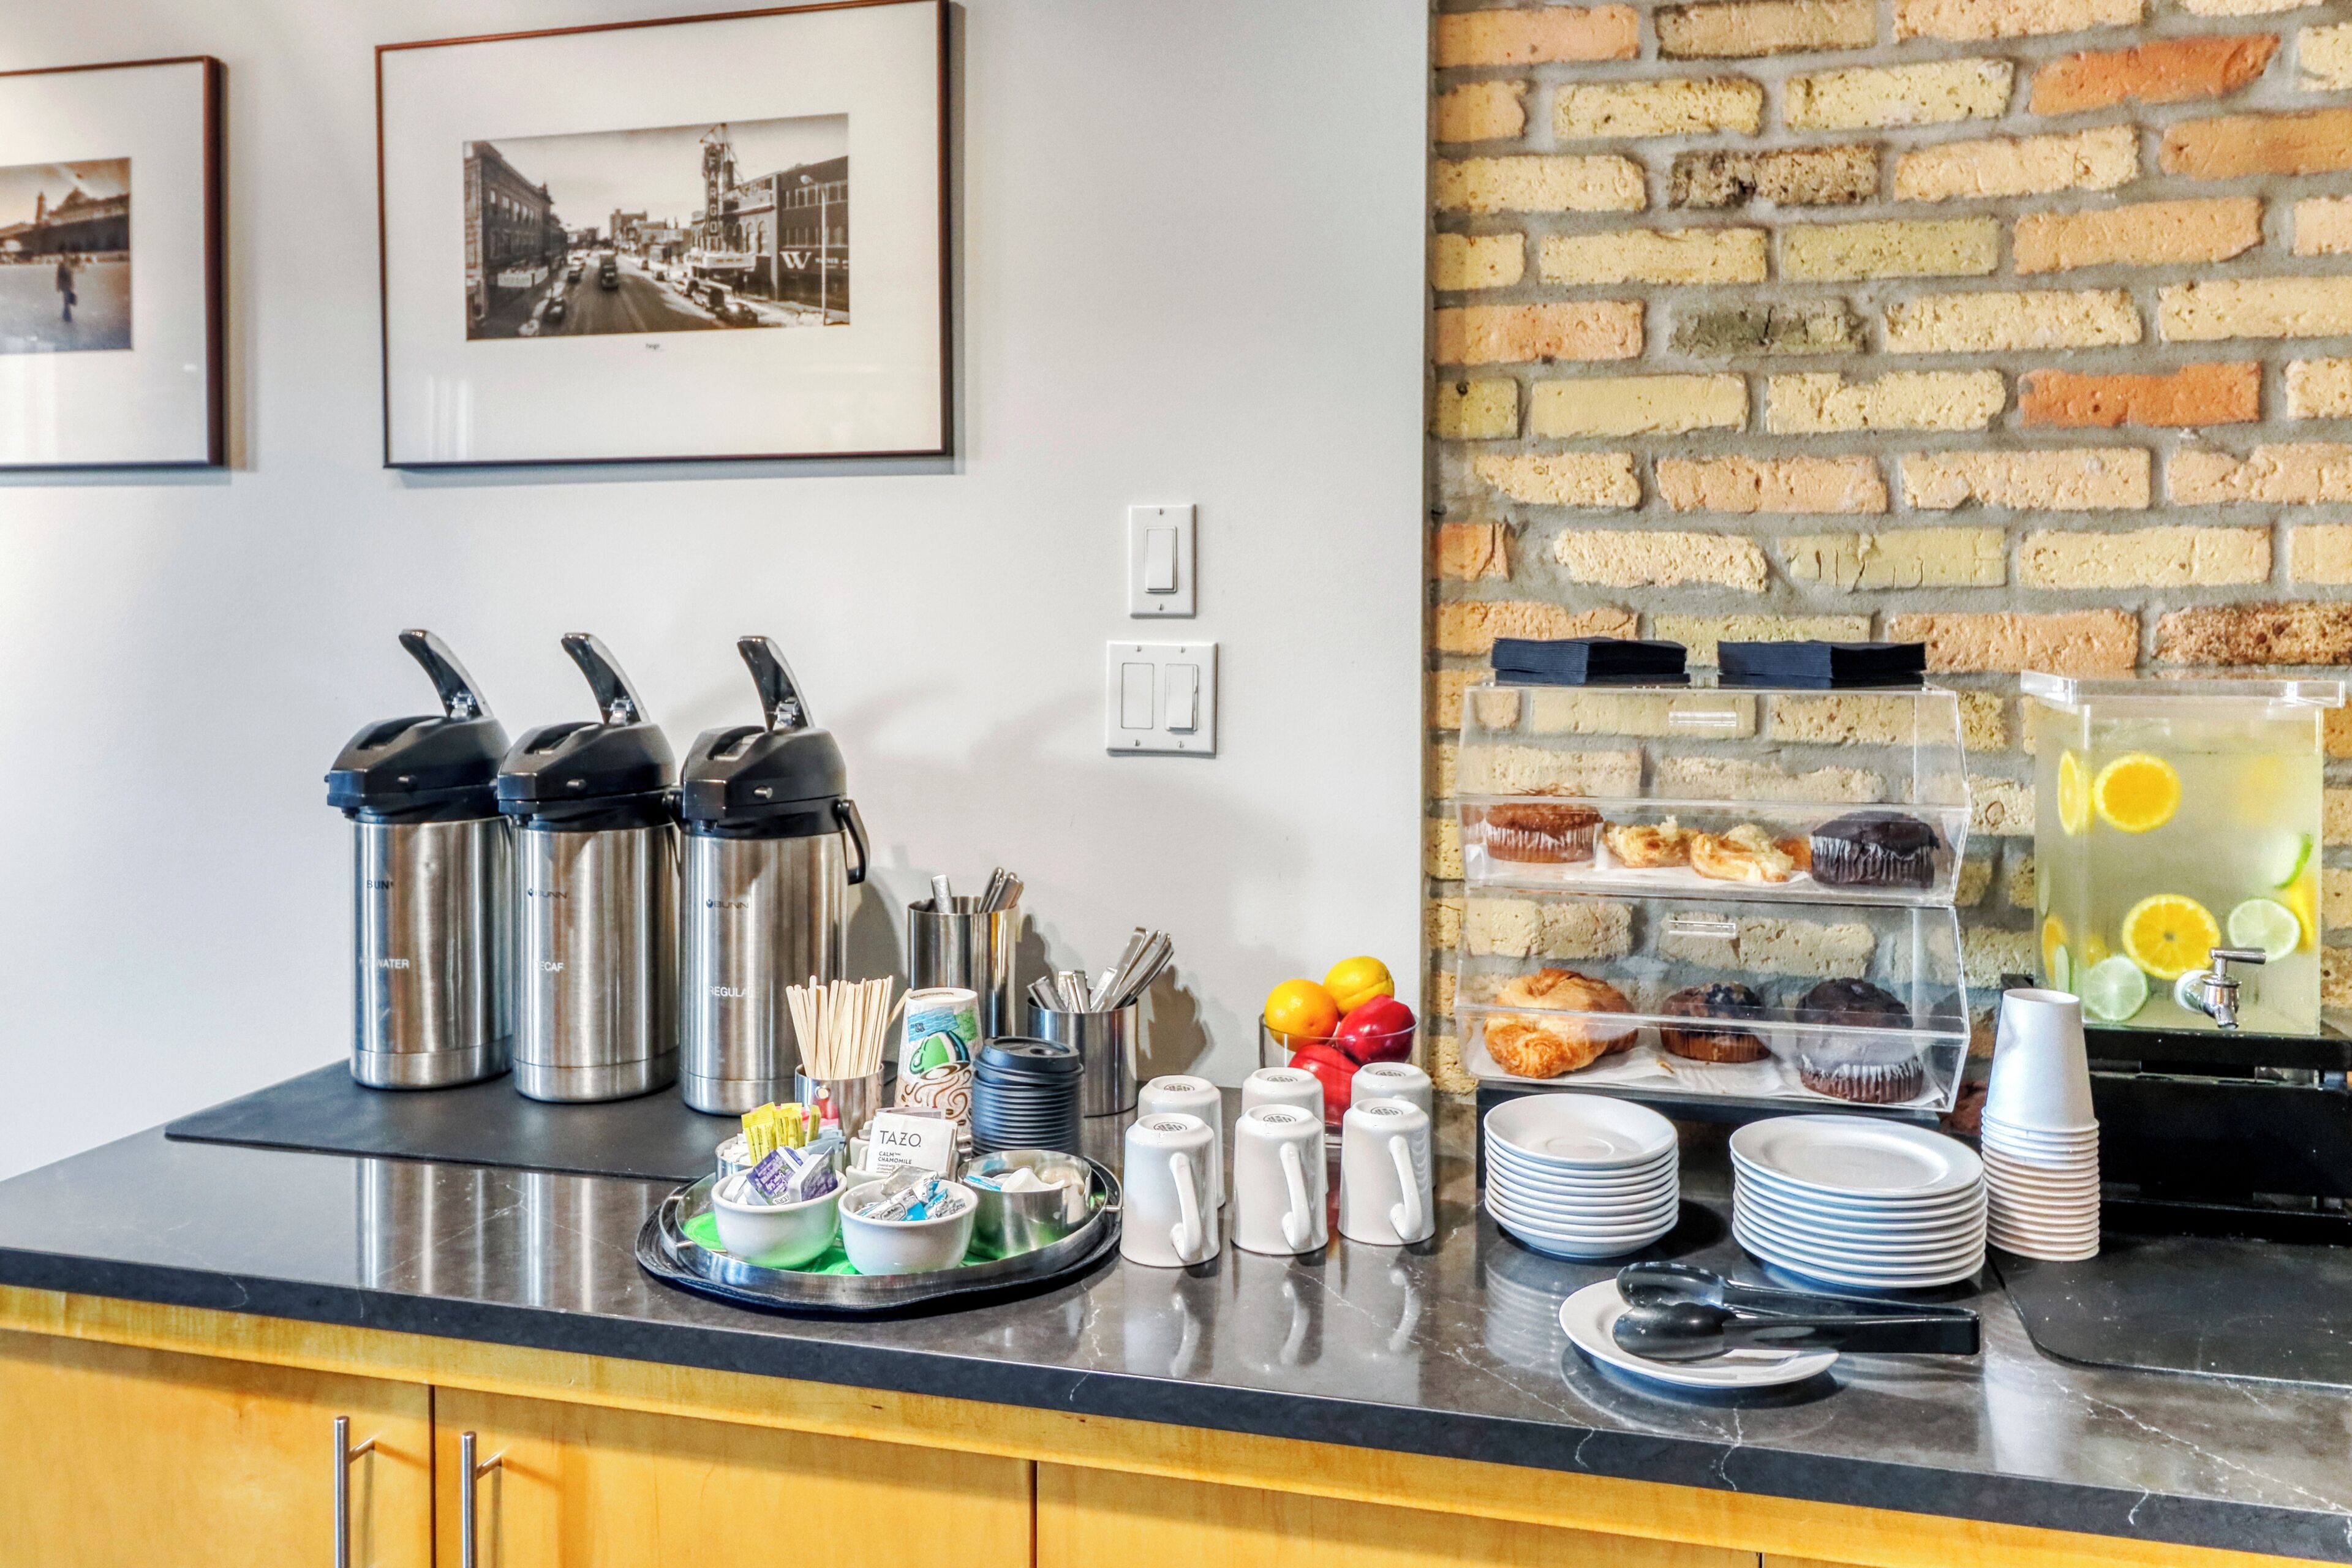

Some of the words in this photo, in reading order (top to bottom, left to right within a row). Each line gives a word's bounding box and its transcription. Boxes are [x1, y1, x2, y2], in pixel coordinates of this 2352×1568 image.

[708, 157, 718, 234] FARGO
[780, 251, 812, 270] W
[367, 880, 394, 891] BUN
[535, 961, 564, 972] ECAF
[709, 986, 756, 998] REGULA
[878, 1156, 912, 1165] CHAMOMILE
